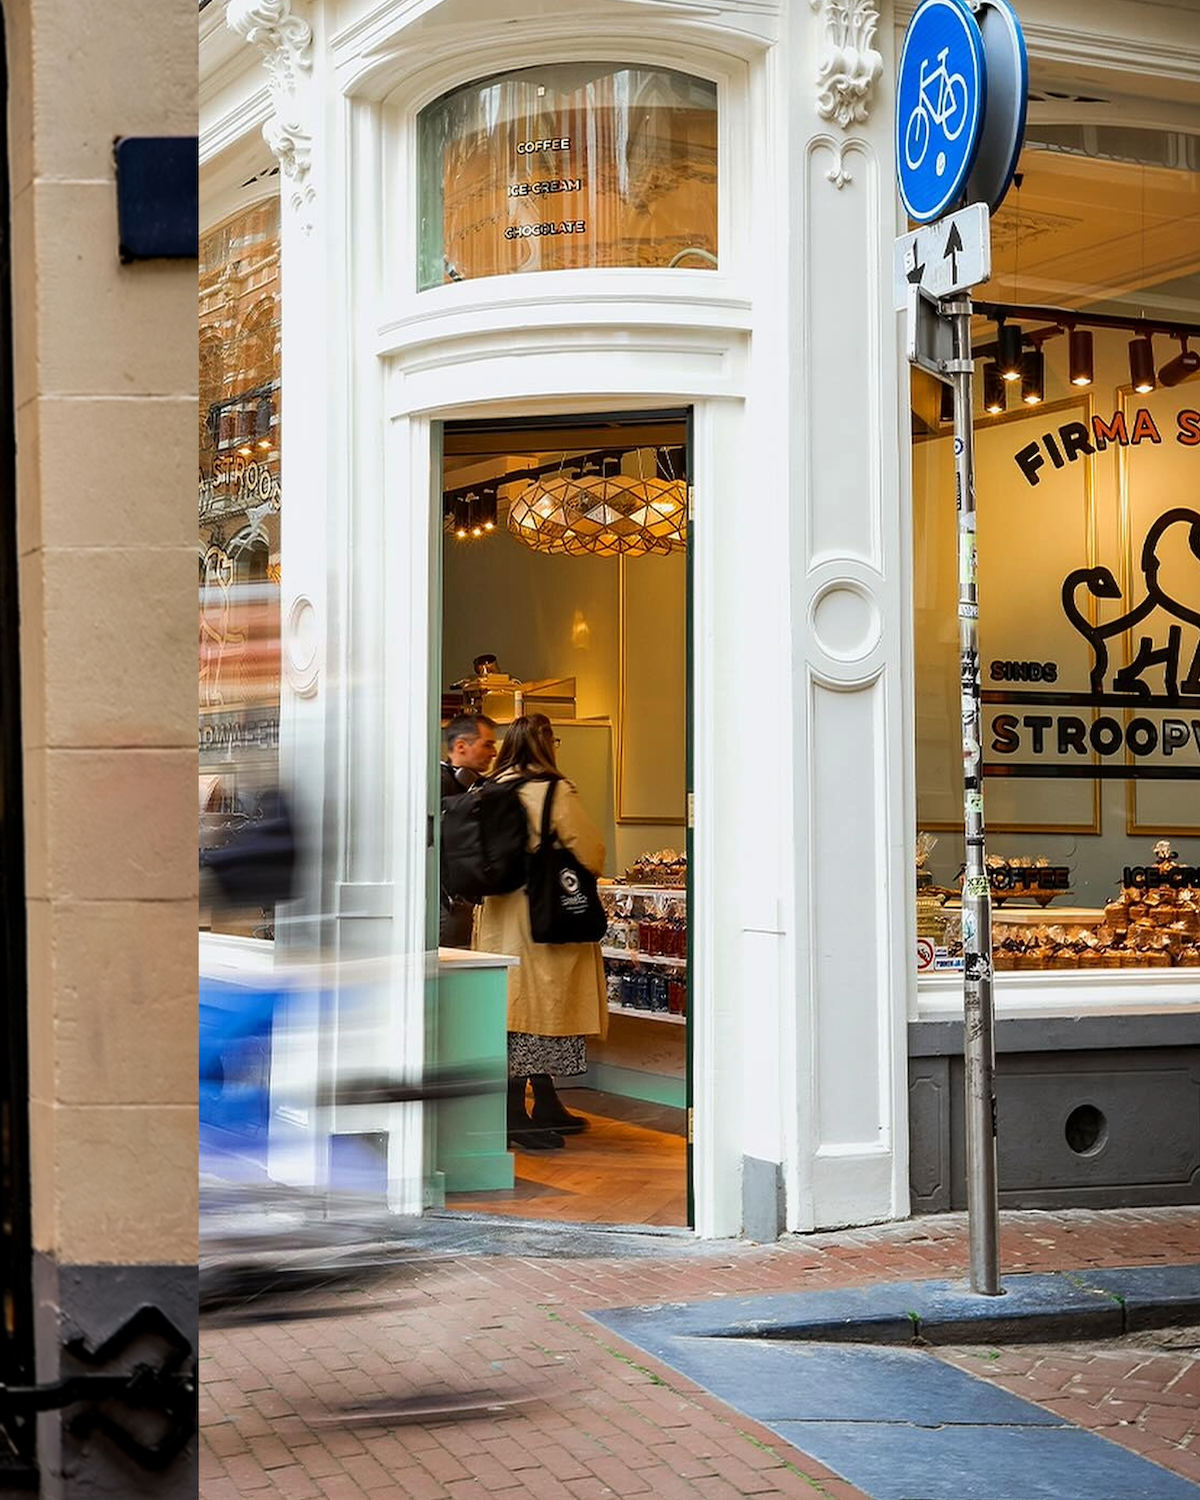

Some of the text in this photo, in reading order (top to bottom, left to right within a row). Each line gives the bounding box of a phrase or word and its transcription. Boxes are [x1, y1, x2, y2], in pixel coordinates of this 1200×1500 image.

[516, 137, 571, 155] COFFEE
[507, 178, 582, 198] ICE-CREAM
[503, 220, 587, 240] CHOCOLATE
[1013, 408, 1162, 487] FIRMA
[990, 661, 1058, 683] SINDS
[981, 865, 1071, 890] OFFEE
